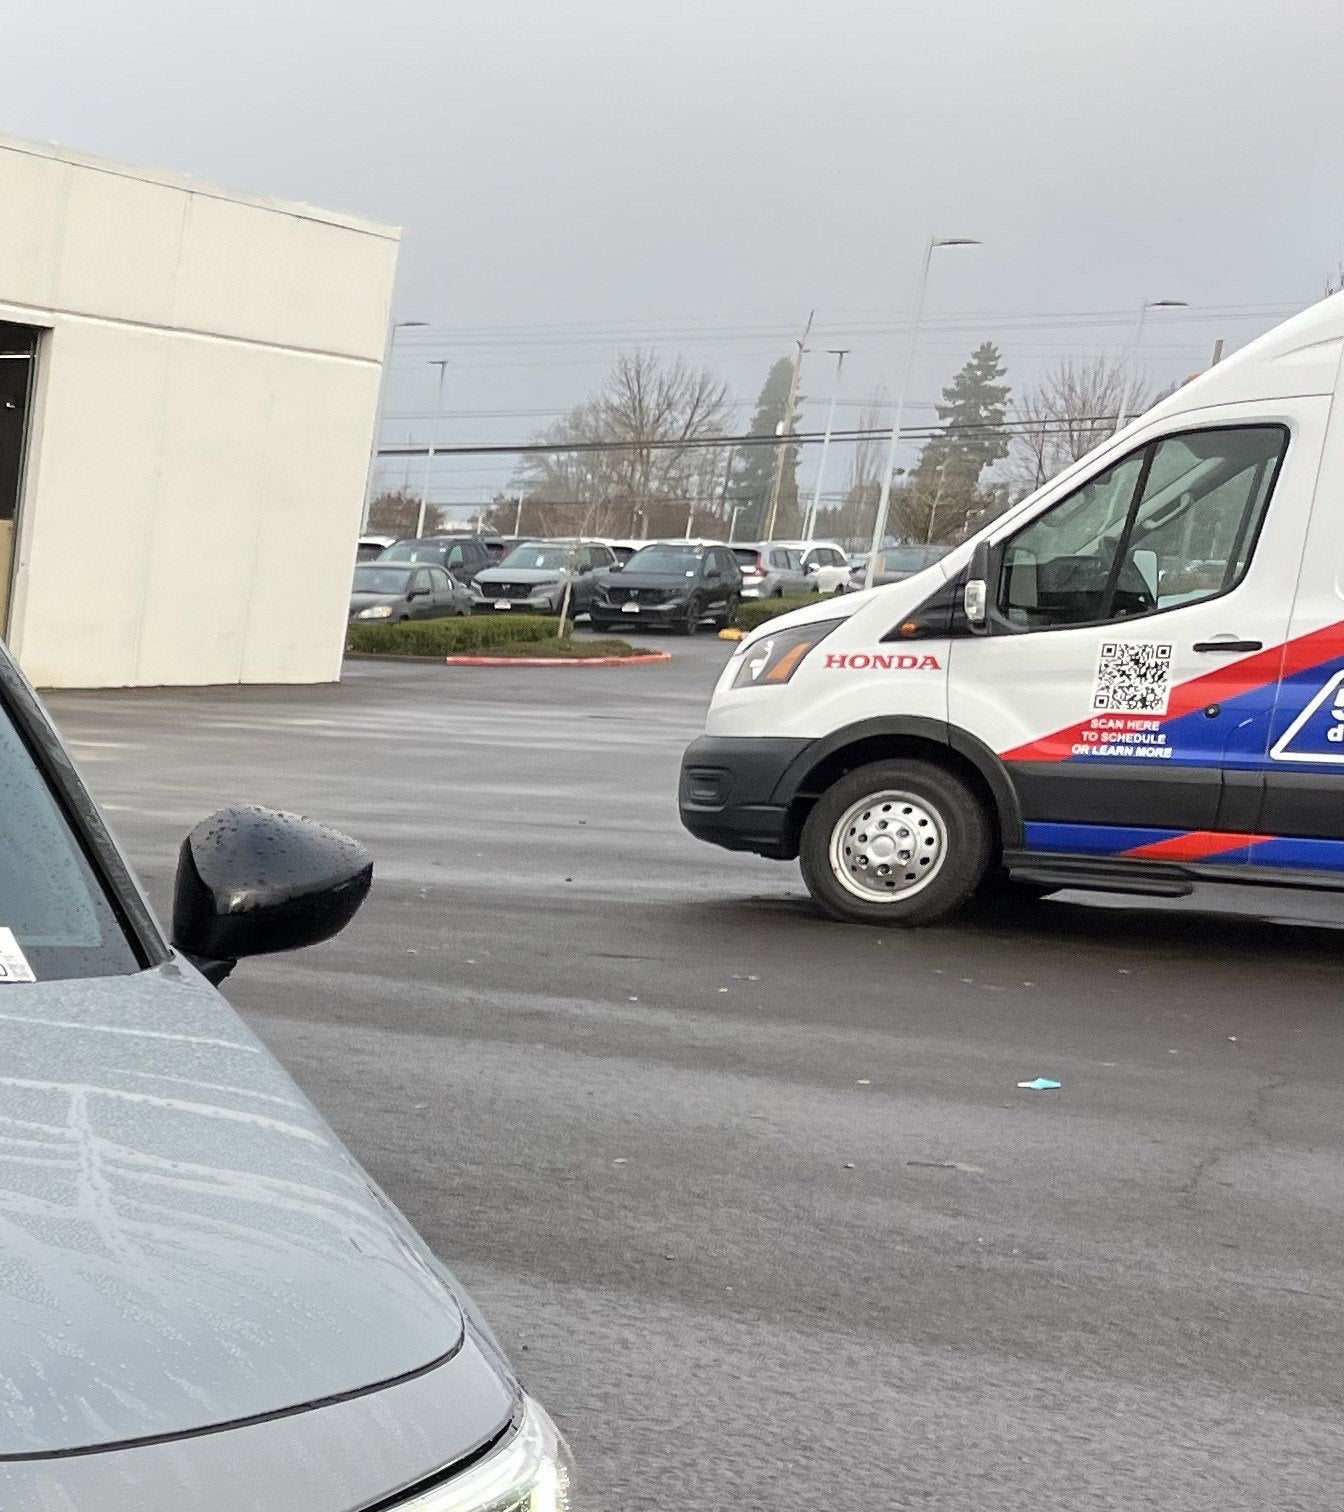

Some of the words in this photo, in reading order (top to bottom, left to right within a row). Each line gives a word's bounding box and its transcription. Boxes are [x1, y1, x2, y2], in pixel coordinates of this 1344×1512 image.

[823, 654, 942, 670] HONDA
[1090, 718, 1125, 729] SCAN
[1126, 720, 1162, 731] HERE
[1081, 730, 1099, 741] TO
[1100, 731, 1166, 744] SCHEDULE
[1071, 743, 1090, 754] OR
[1092, 745, 1133, 756] LEARN
[1135, 746, 1173, 758] MORE
